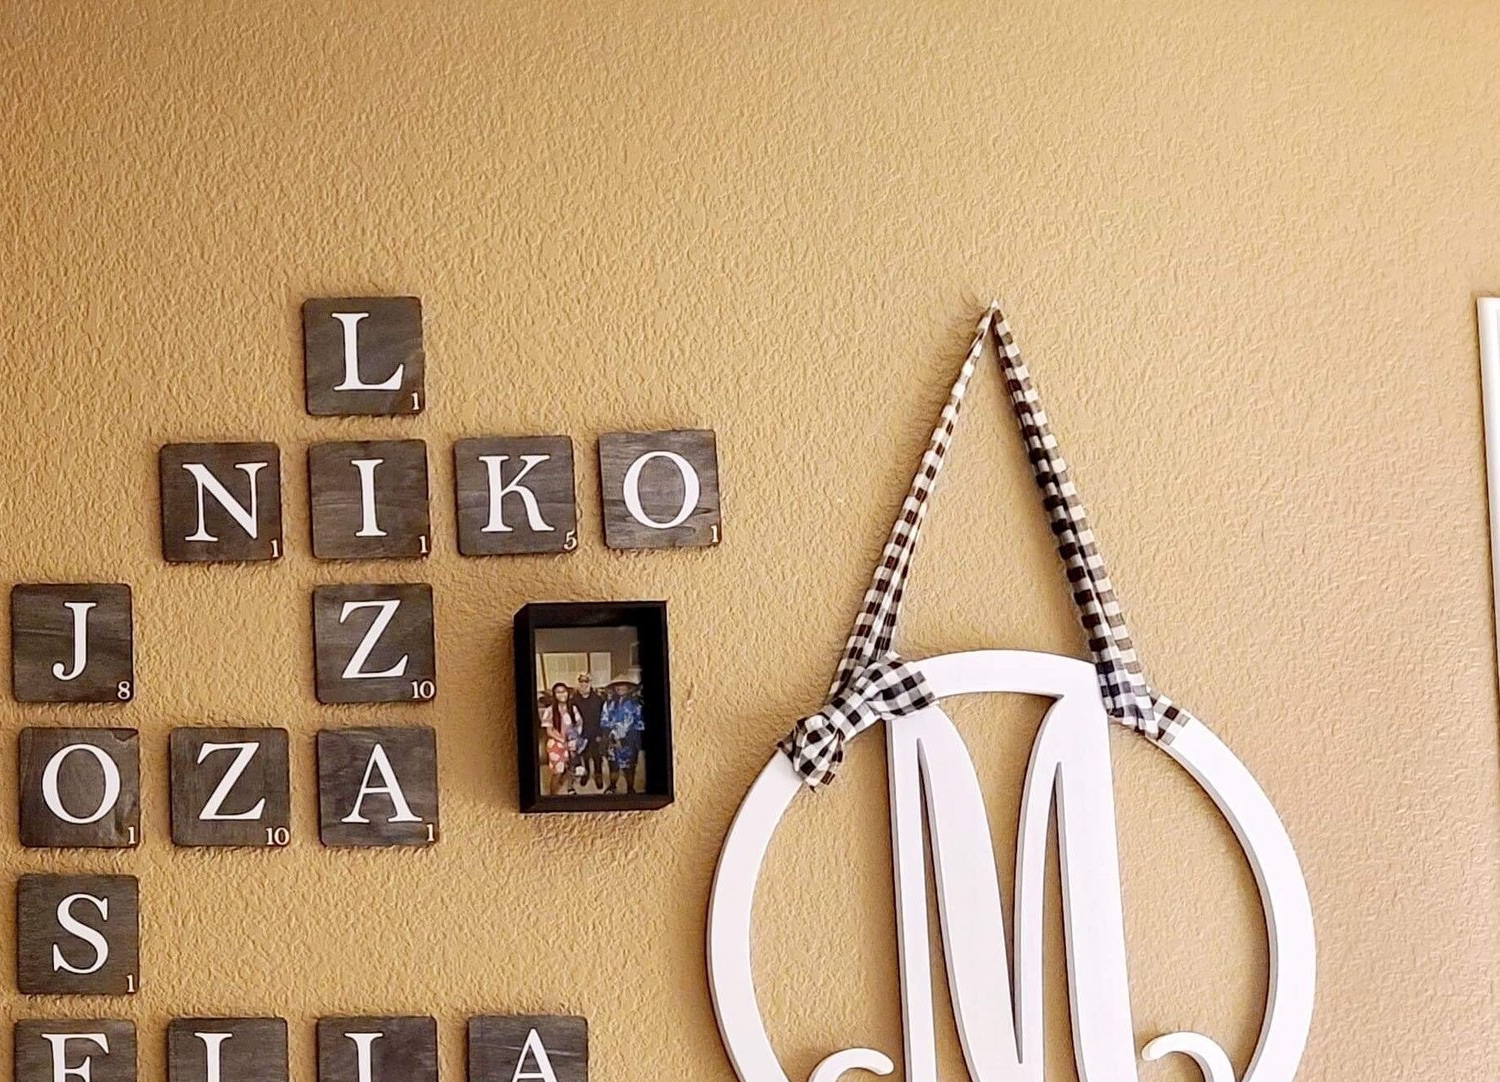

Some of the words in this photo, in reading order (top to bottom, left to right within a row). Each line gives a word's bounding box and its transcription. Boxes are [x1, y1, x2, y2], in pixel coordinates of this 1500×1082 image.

[562, 529, 578, 550] 5
[116, 681, 132, 700] 8
[410, 680, 436, 699] 10
[265, 827, 291, 845] 10
